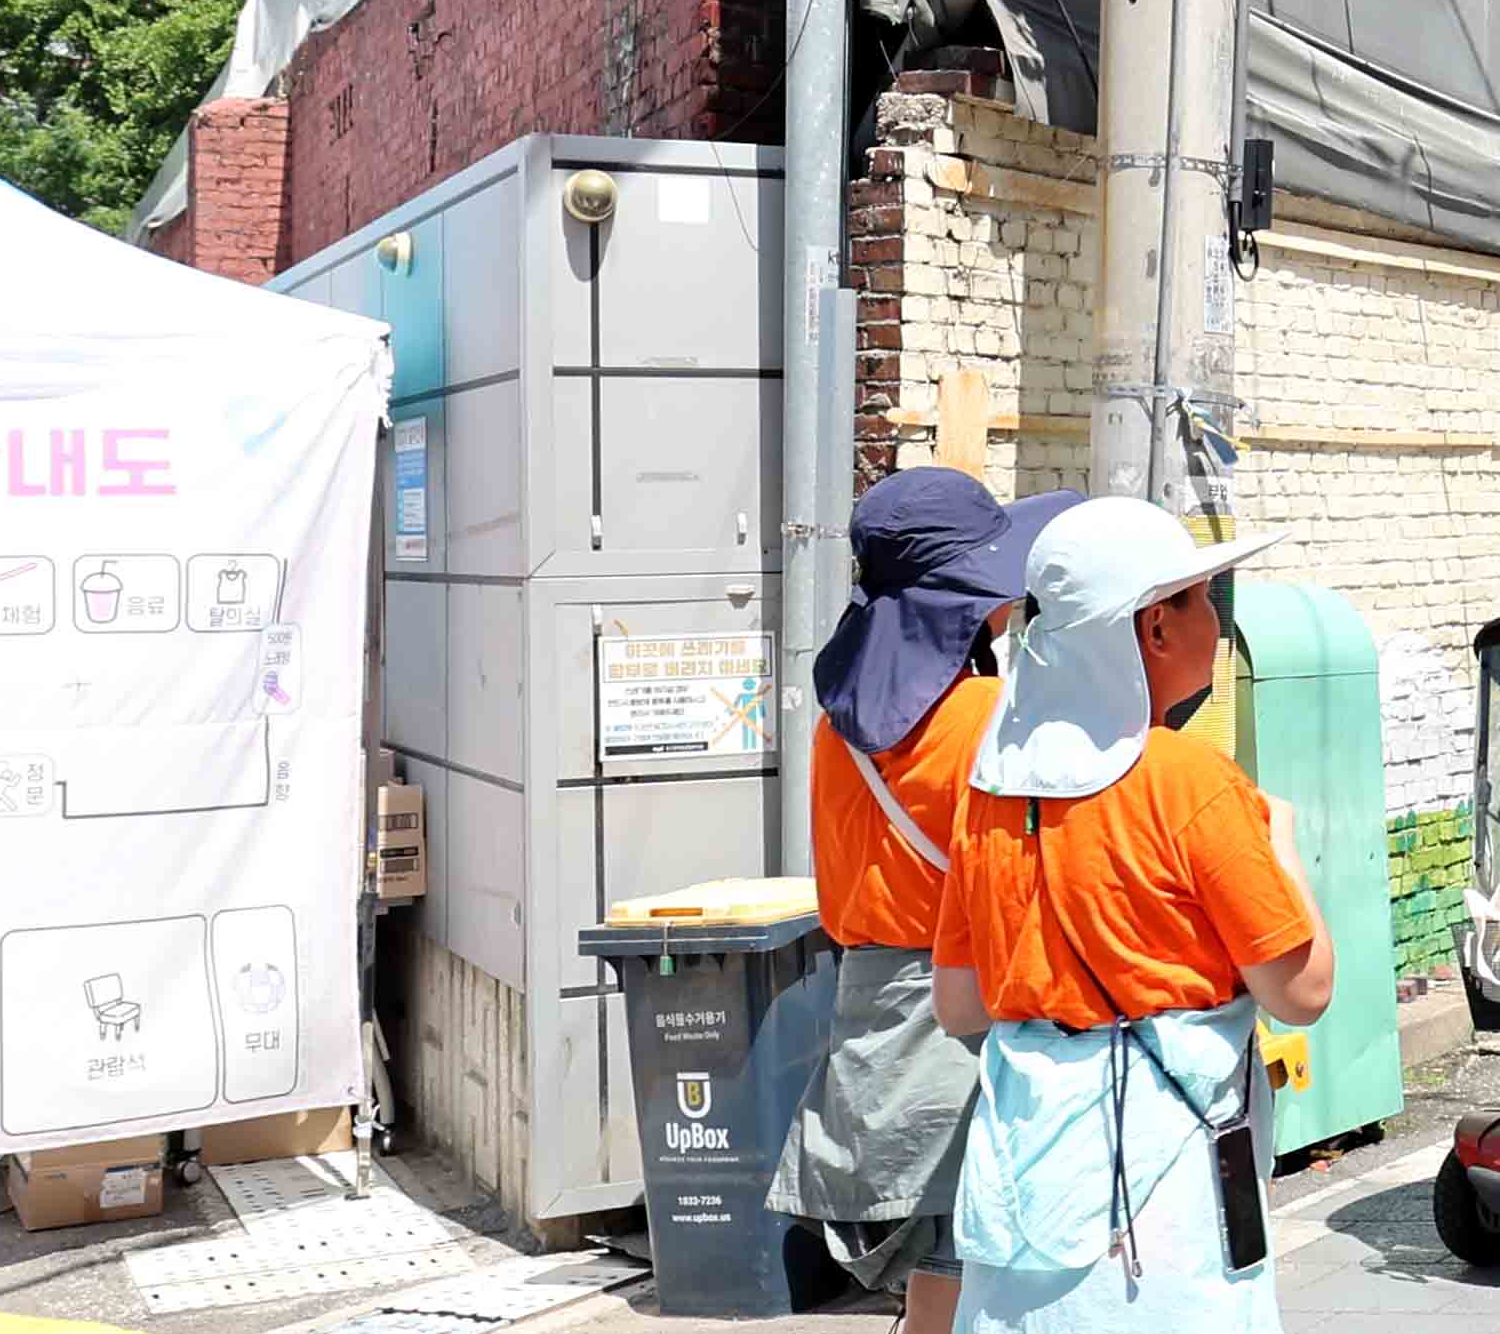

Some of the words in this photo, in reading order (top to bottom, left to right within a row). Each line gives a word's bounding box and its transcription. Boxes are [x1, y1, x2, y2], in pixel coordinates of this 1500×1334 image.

[127, 595, 165, 616] 음료
[209, 606, 261, 627] 탈의실
[245, 1029, 281, 1053] 무대
[86, 1053, 146, 1081] 관람석
[665, 1122, 730, 1154] UpBox
